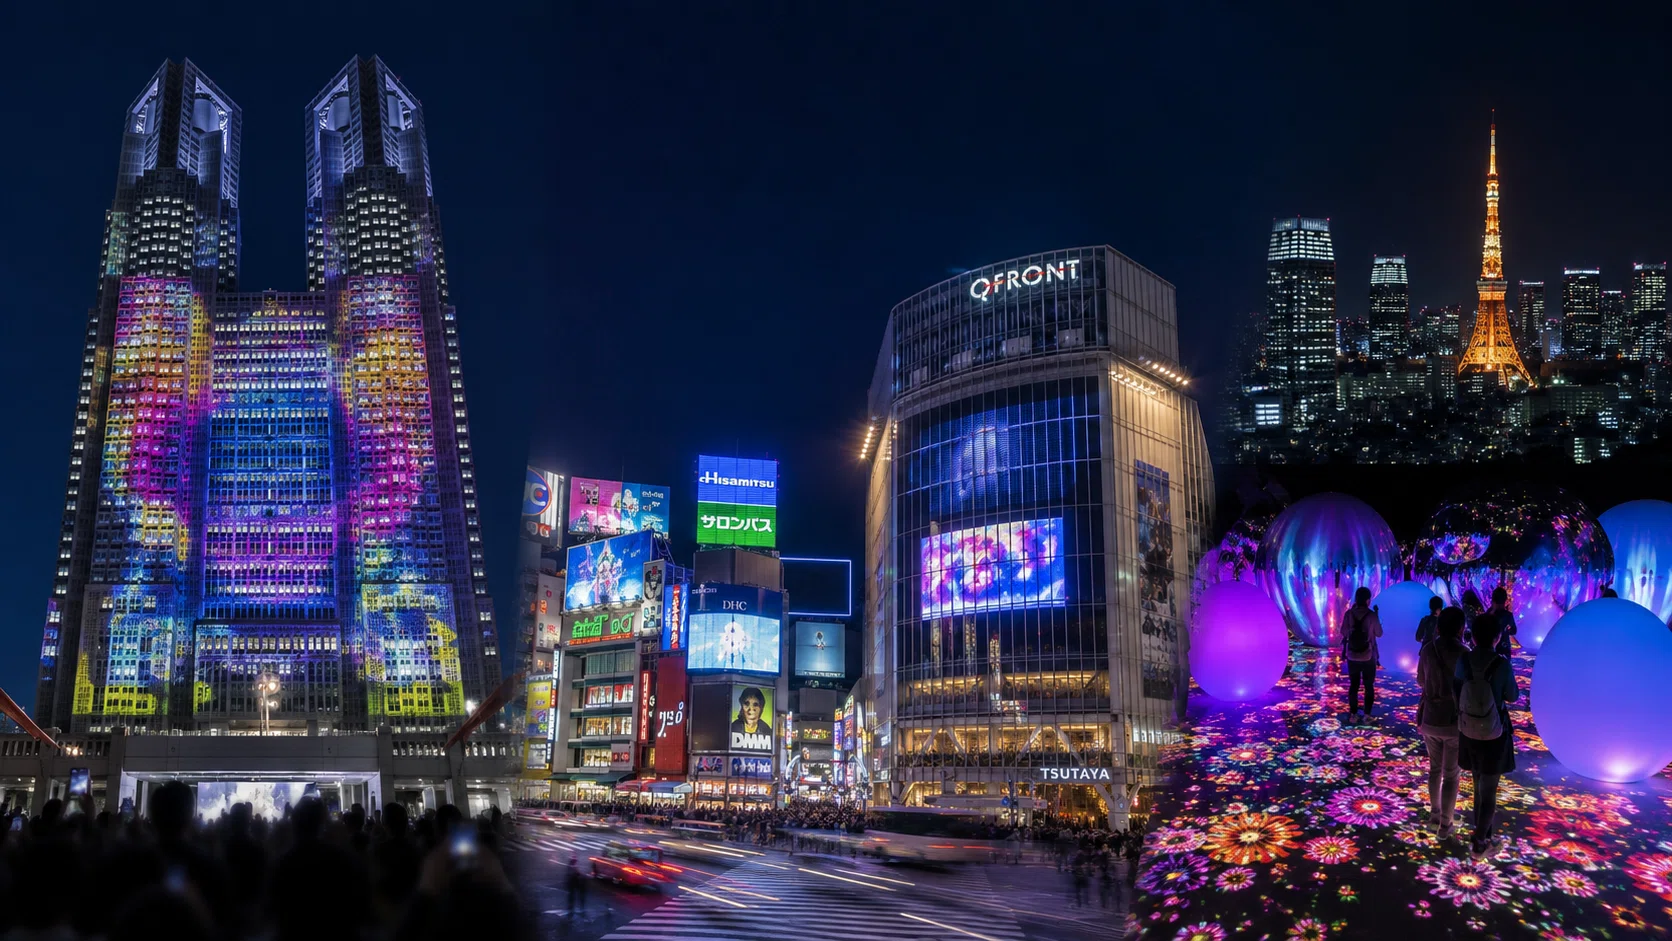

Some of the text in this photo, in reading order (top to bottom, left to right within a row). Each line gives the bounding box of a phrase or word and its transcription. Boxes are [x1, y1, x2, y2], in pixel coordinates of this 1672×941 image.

[970, 259, 1080, 301] QFRONT
[722, 600, 747, 611] DHC
[731, 732, 772, 750] DMM
[1040, 767, 1110, 780] TSUTAYA
